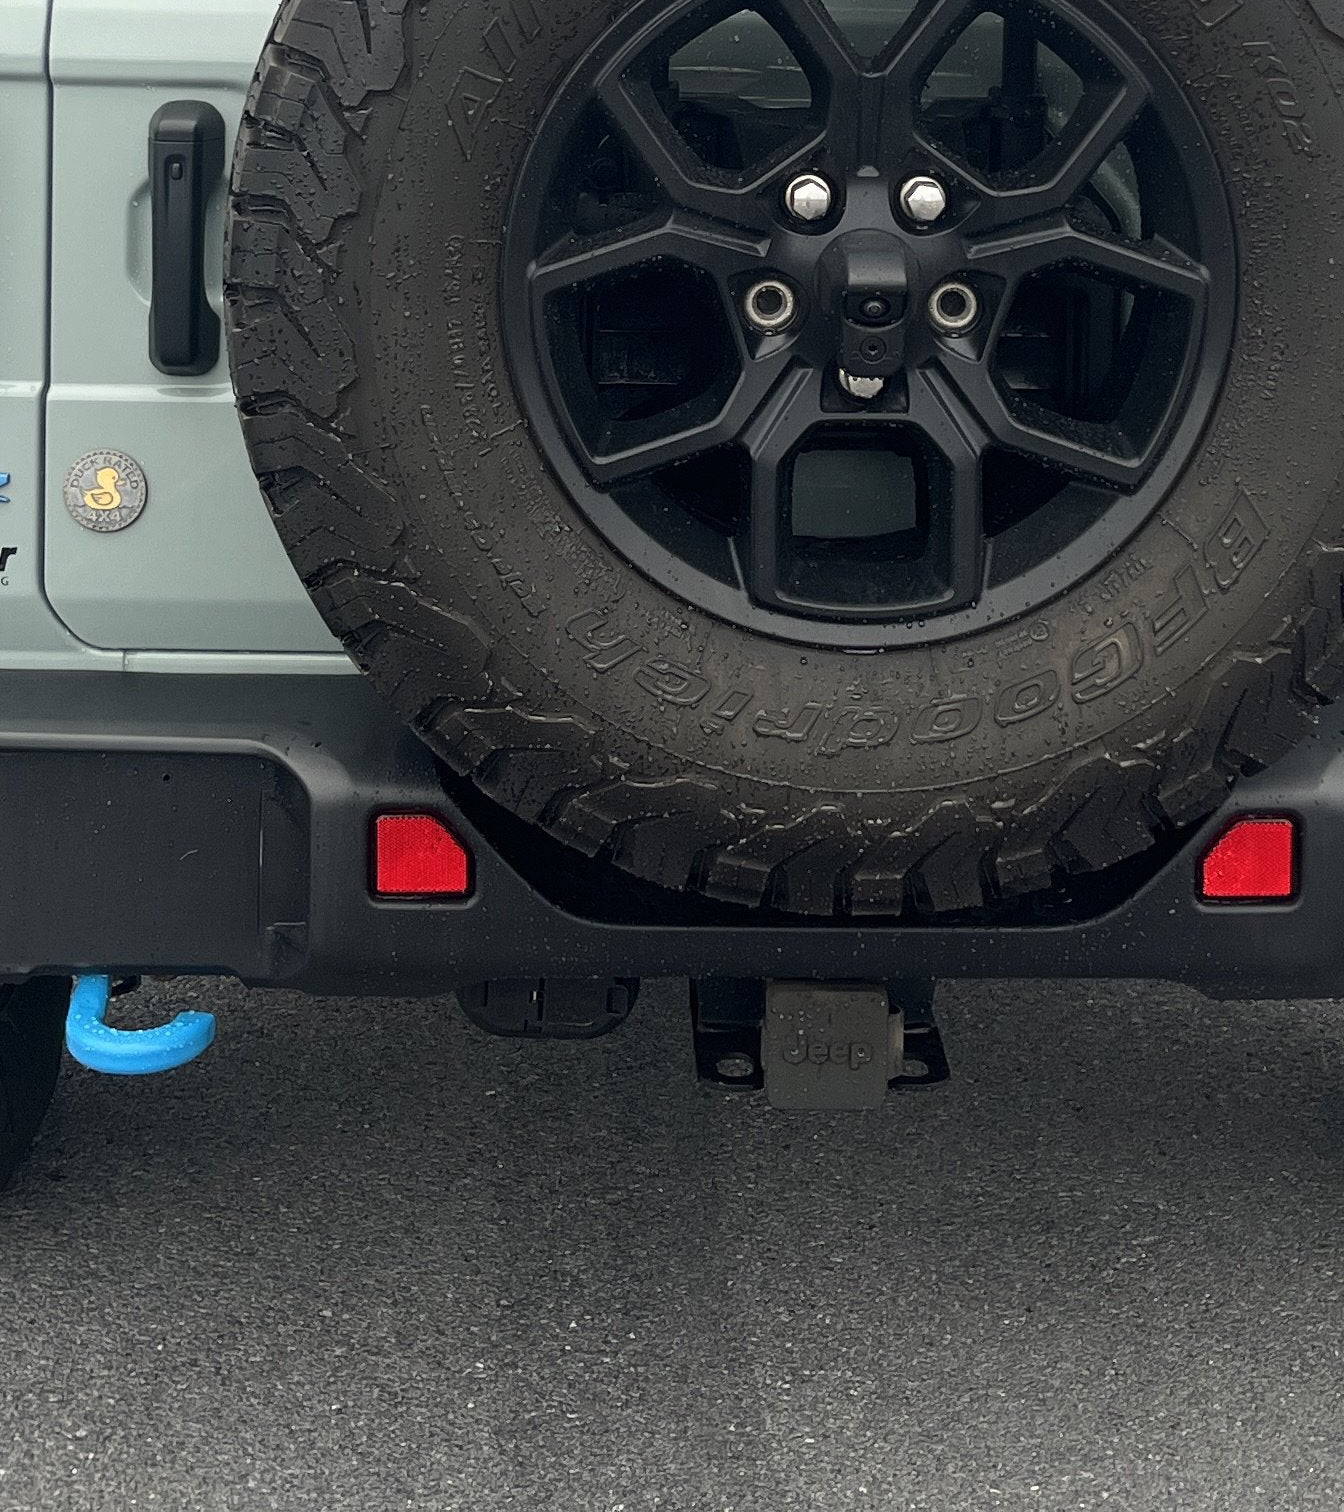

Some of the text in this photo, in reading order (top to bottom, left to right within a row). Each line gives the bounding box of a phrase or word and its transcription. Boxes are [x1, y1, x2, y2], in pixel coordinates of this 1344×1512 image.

[70, 456, 140, 491] DUCK RATED
[565, 488, 1273, 756] BFGoodrich
